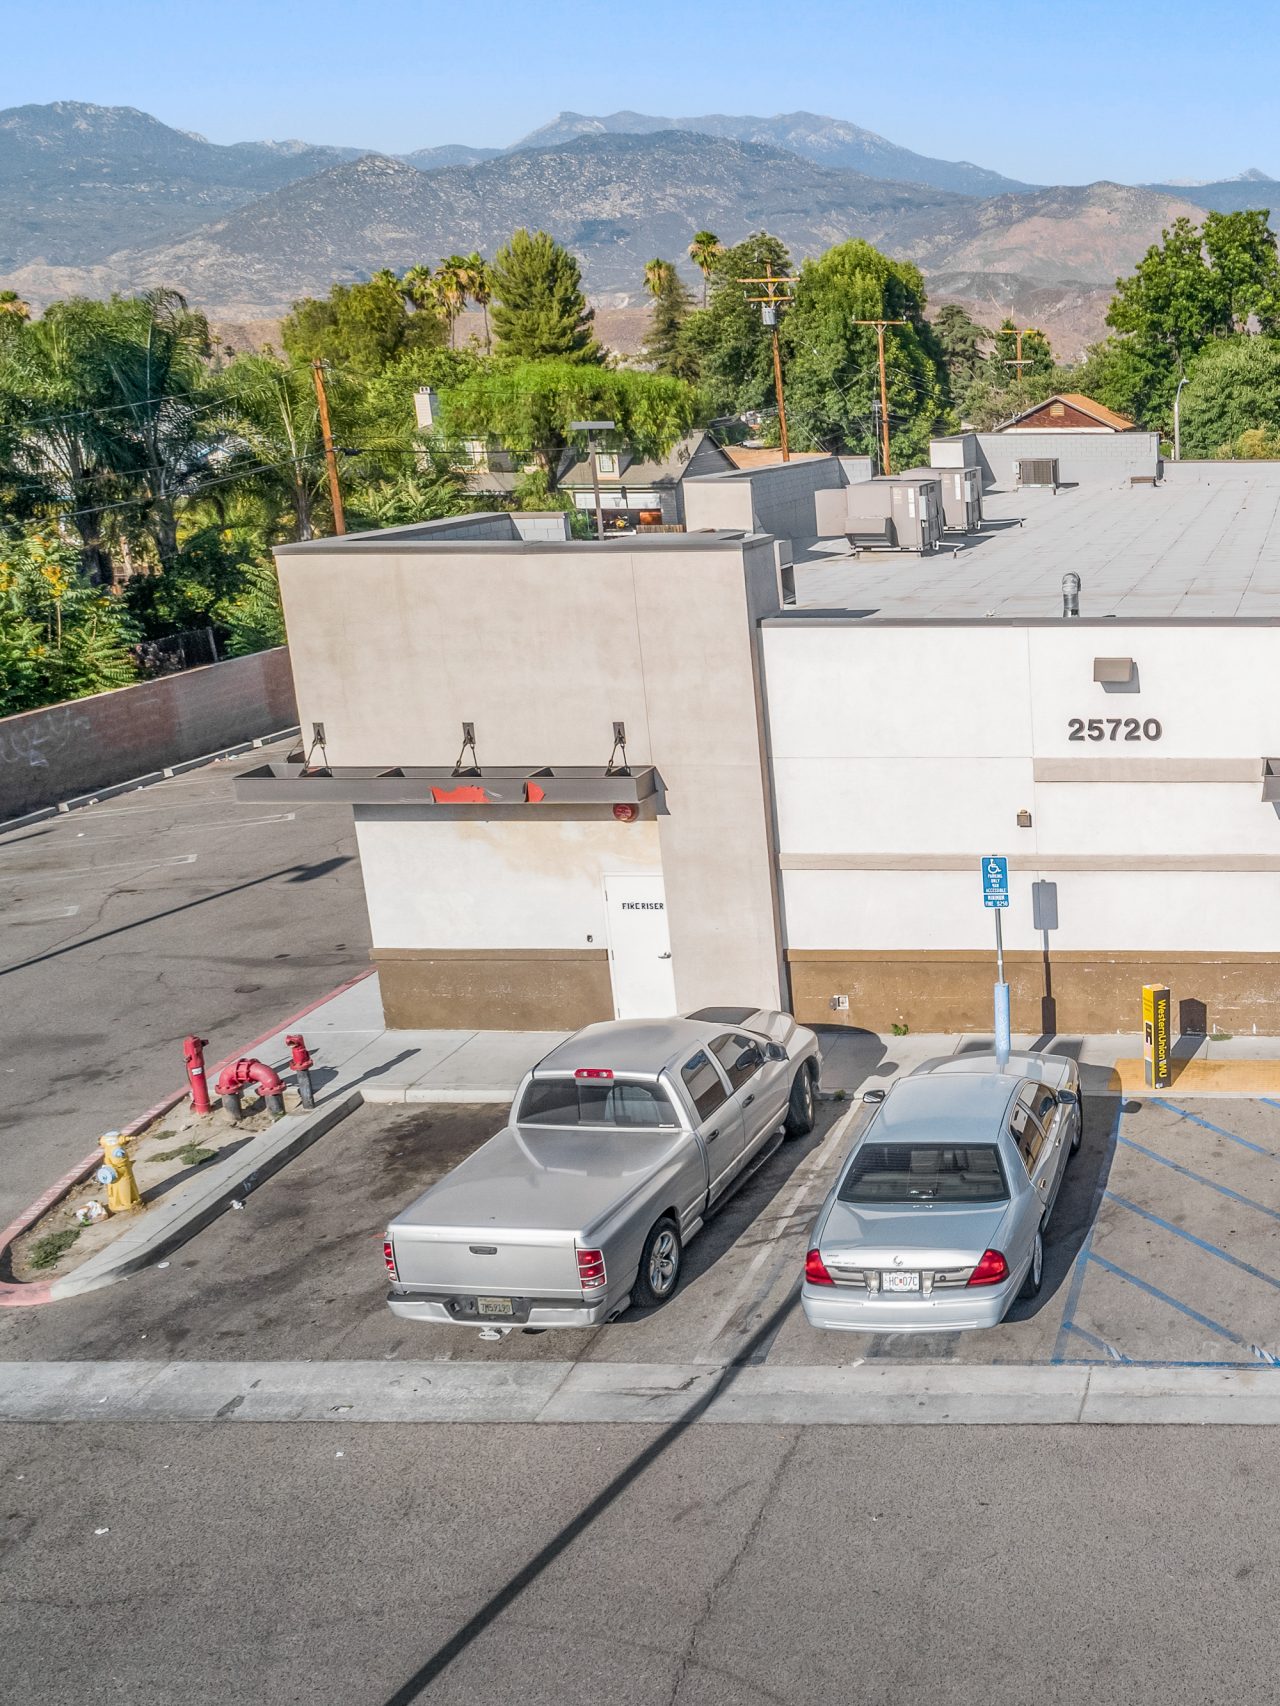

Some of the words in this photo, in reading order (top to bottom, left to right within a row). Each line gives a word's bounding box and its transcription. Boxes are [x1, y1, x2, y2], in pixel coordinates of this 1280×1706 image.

[1067, 717, 1163, 742] 25720
[622, 902, 640, 910] FIRE
[641, 902, 664, 910] RISER
